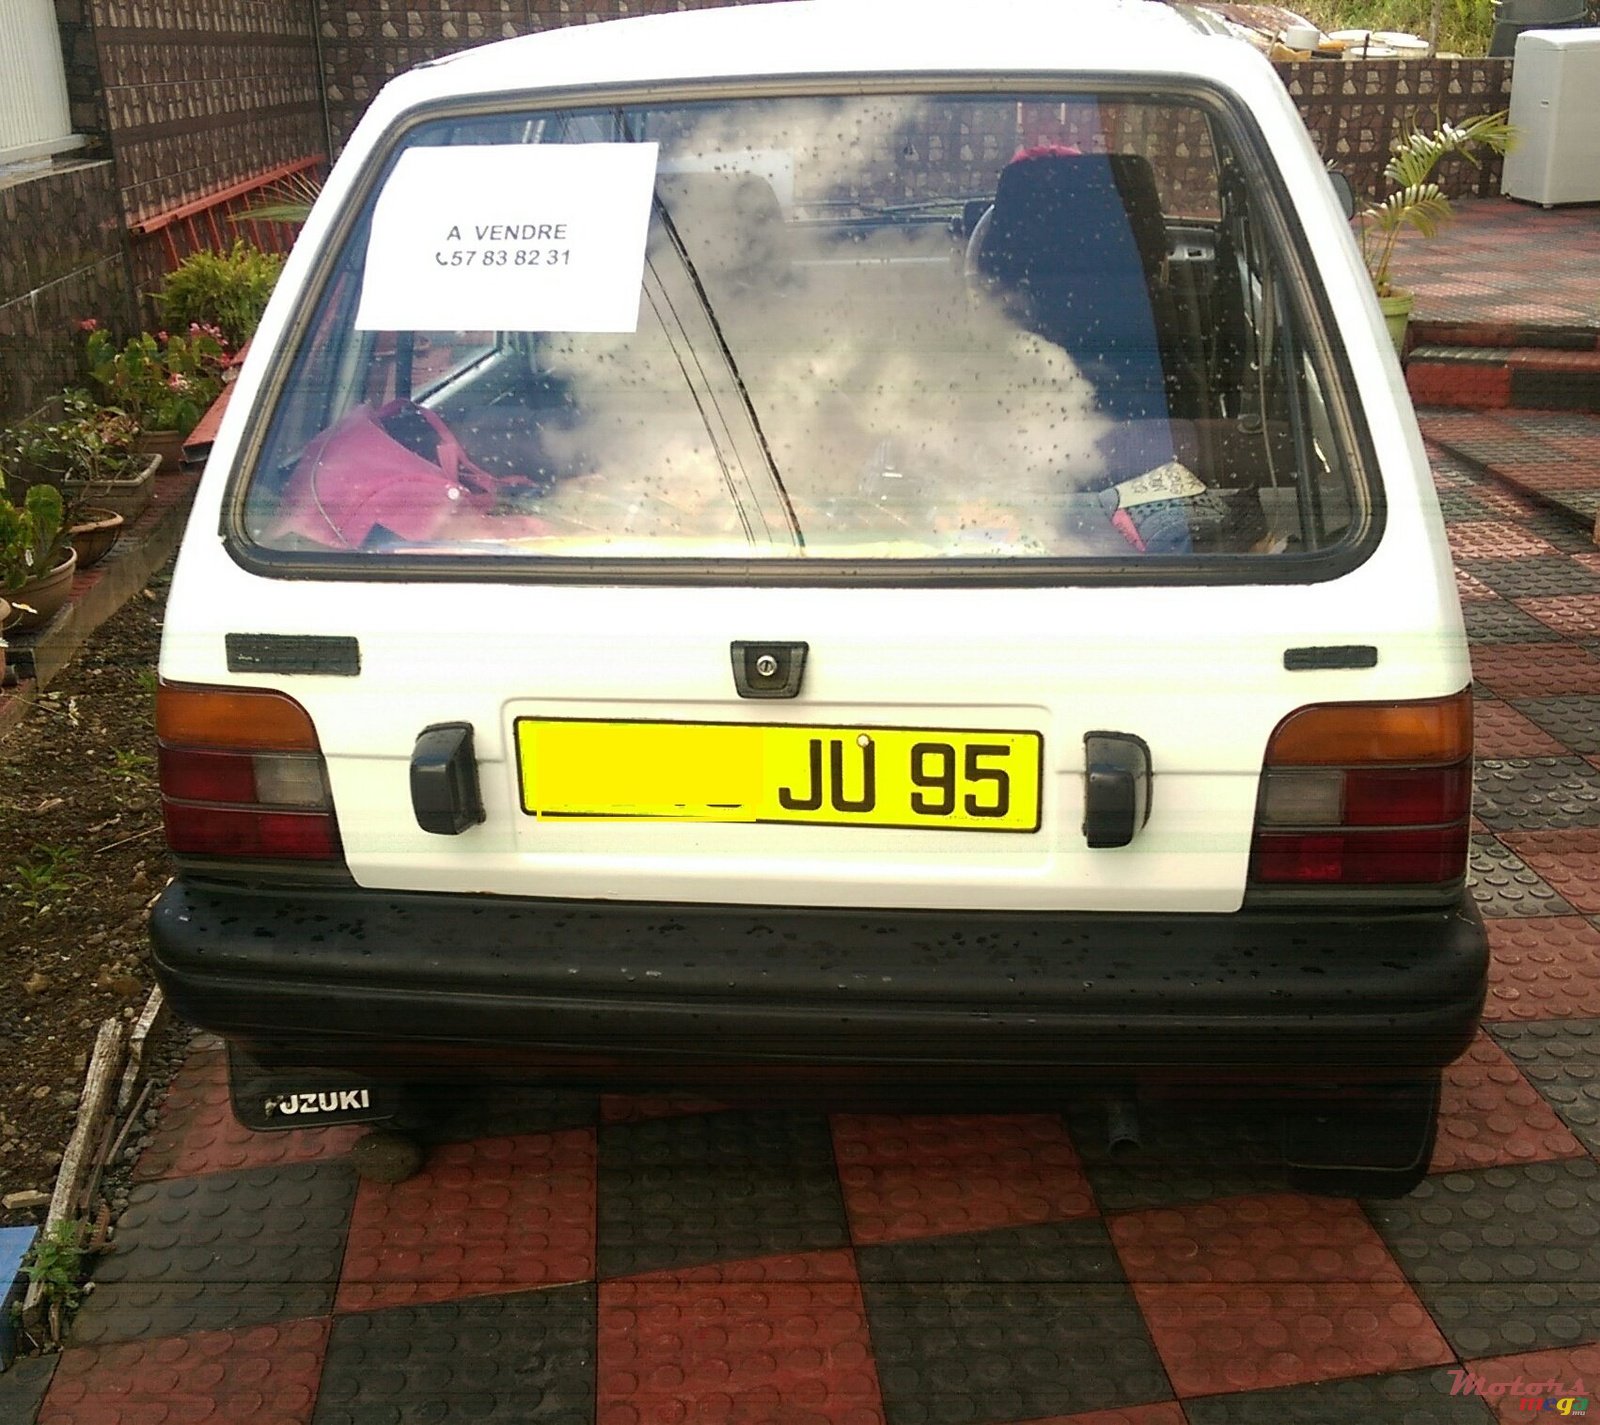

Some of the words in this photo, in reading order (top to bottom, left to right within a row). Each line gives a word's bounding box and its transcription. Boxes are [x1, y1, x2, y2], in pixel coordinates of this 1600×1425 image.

[446, 225, 462, 241] A
[475, 224, 568, 241] VENDRE
[450, 250, 477, 267] 57
[482, 250, 508, 266] 83
[514, 249, 540, 266] 82
[546, 249, 570, 266] 31
[778, 738, 876, 813] JU
[910, 742, 1012, 818] 95
[264, 1089, 370, 1121] UZUKI
